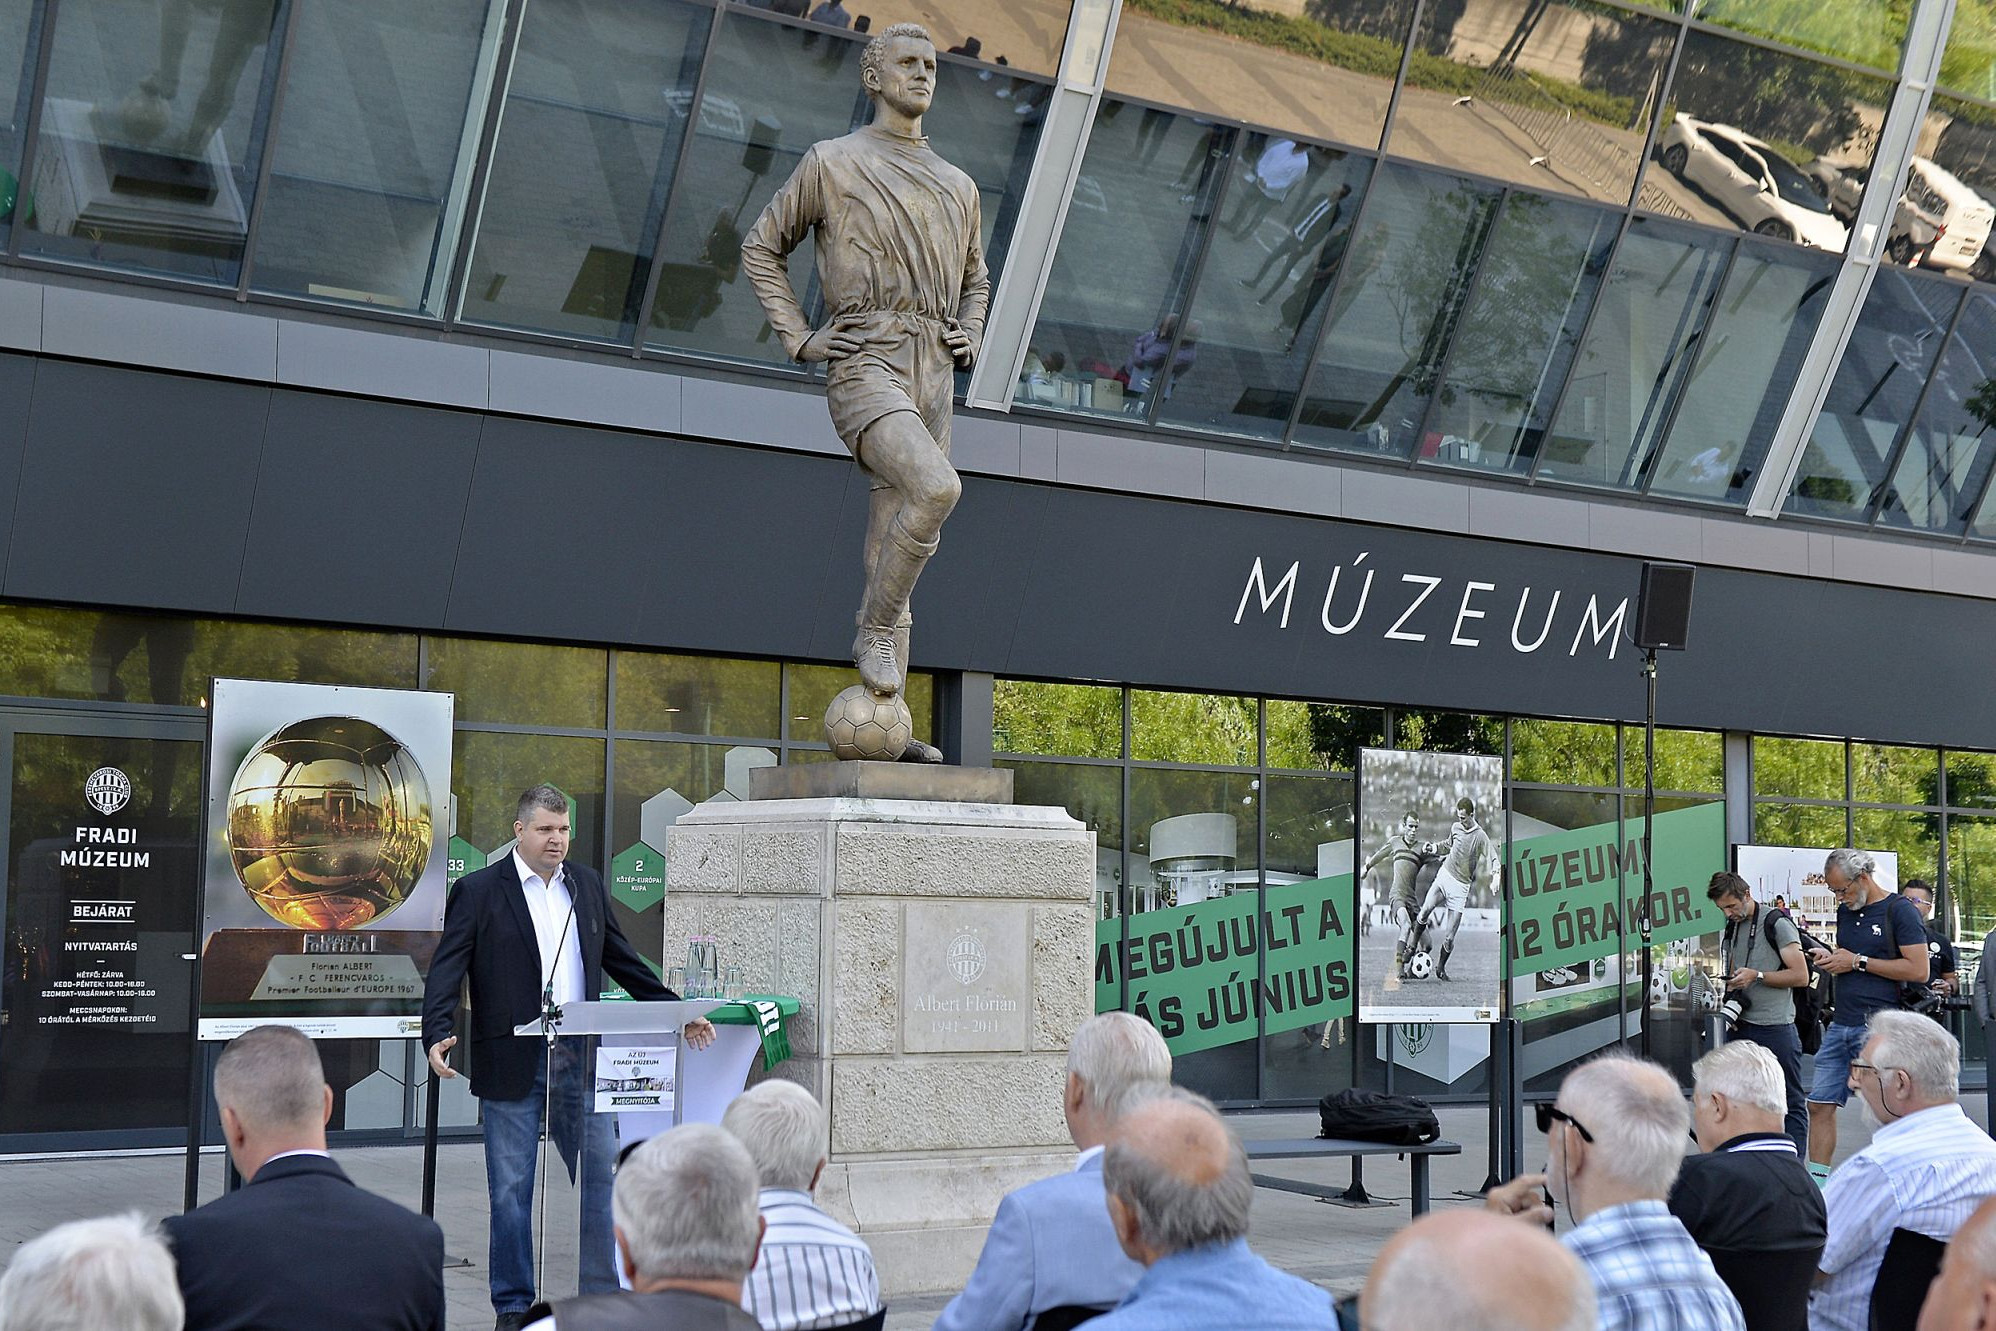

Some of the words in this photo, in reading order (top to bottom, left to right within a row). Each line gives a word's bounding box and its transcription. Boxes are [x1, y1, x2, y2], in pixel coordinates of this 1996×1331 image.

[1232, 551, 1628, 660] MÚZEUM
[75, 826, 137, 844] FRADI
[60, 847, 150, 868] MÚZEUM
[635, 860, 644, 872] 2
[73, 903, 133, 917] BEJÁRAT
[1318, 899, 1345, 941] A
[1552, 886, 1702, 950] ÓRAKOR.
[65, 940, 138, 951] NYITVATARTÁS
[342, 962, 373, 970] ALBERT
[101, 970, 124, 978] ZÁRVA
[324, 975, 385, 983] FERENCVAROS
[397, 985, 415, 993] 1967
[1197, 960, 1350, 1030] JÚNIUS
[913, 995, 960, 1012] Albert
[965, 994, 1017, 1012] Florián
[931, 1019, 958, 1033] 1941
[972, 1019, 999, 1033] 2011
